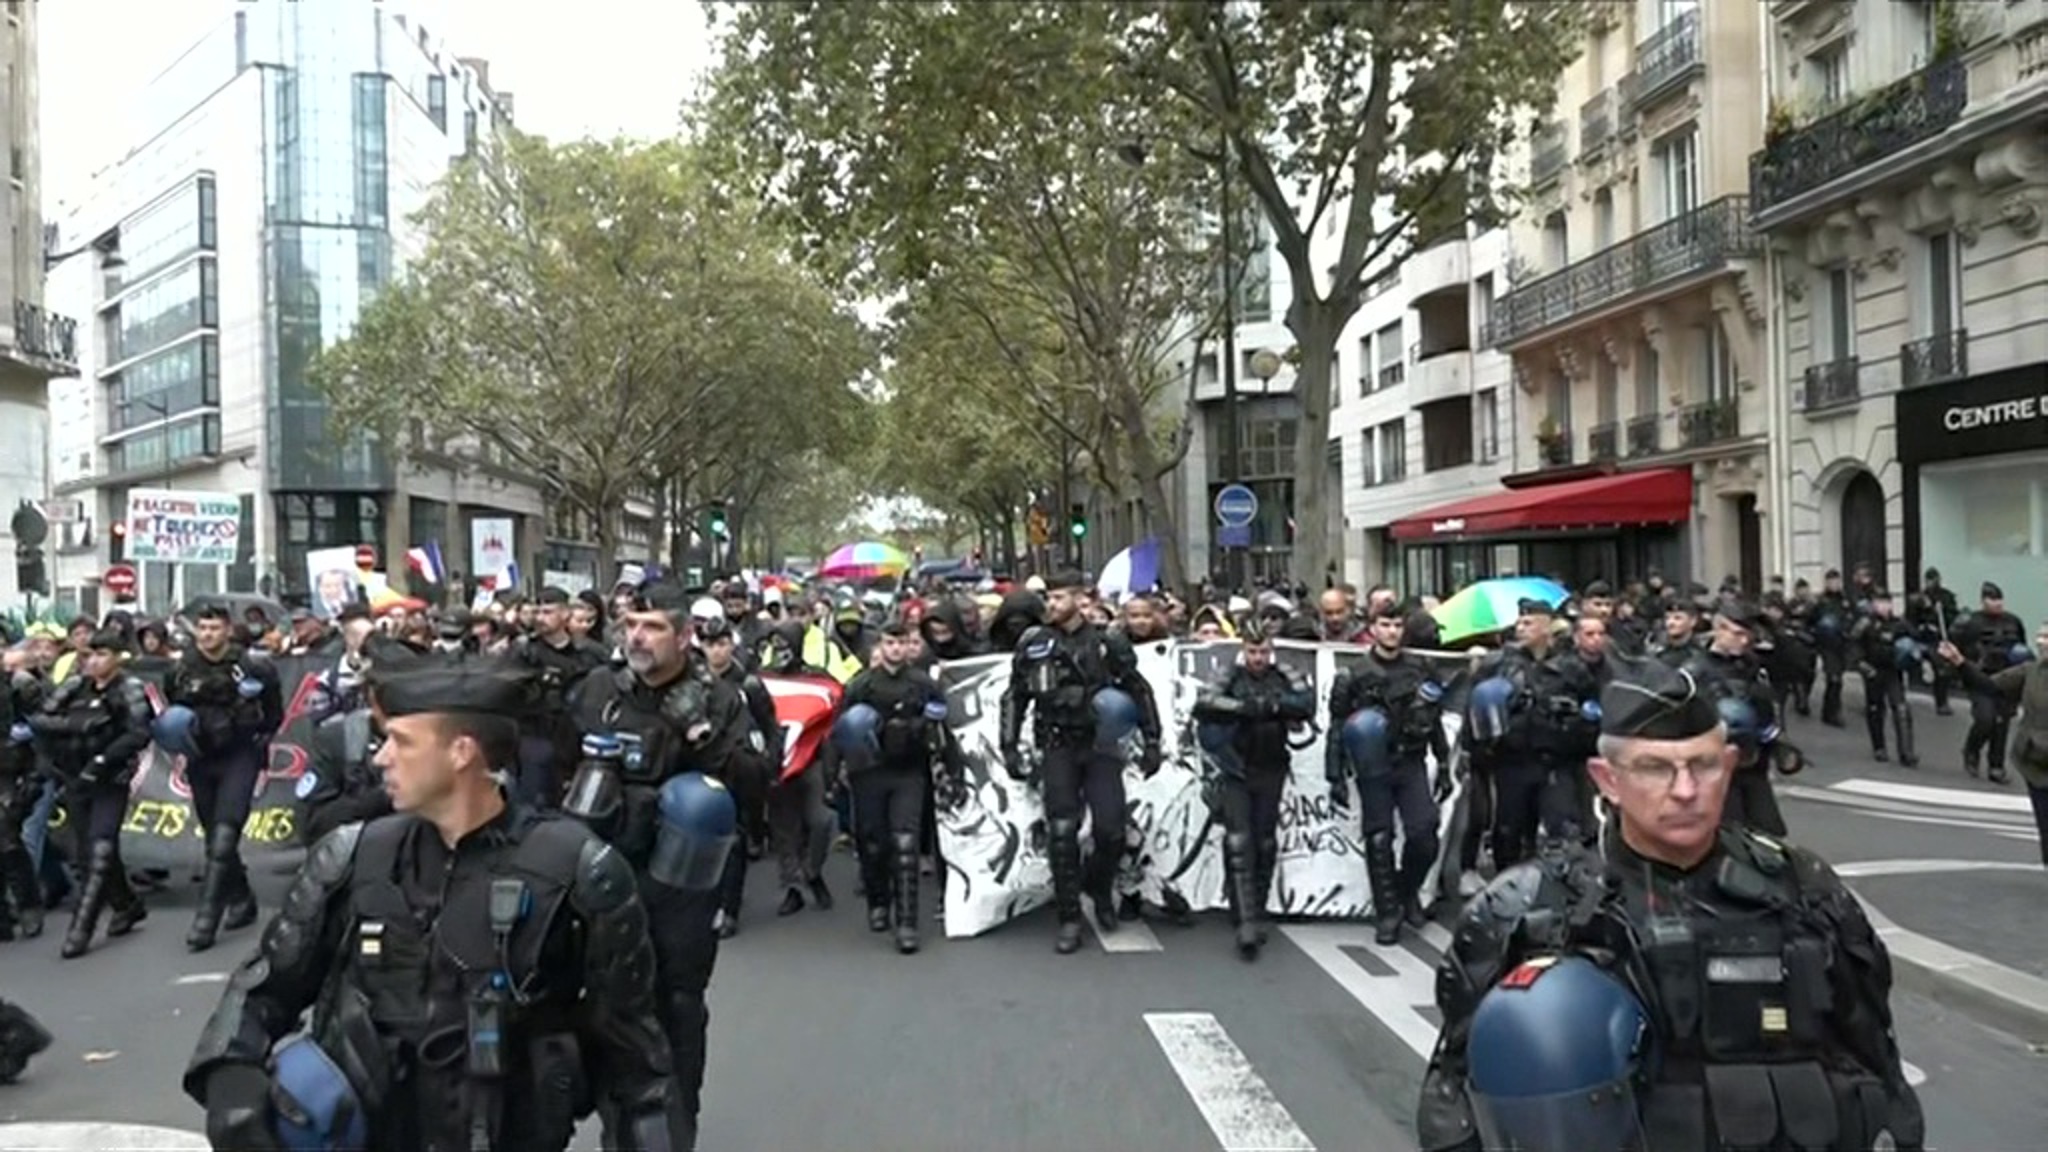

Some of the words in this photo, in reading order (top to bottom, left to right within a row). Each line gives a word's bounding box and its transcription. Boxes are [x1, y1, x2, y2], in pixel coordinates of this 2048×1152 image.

[1944, 397, 2036, 431] CENTRE
[121, 802, 190, 837] LETS
[1280, 794, 1349, 831] BLACK
